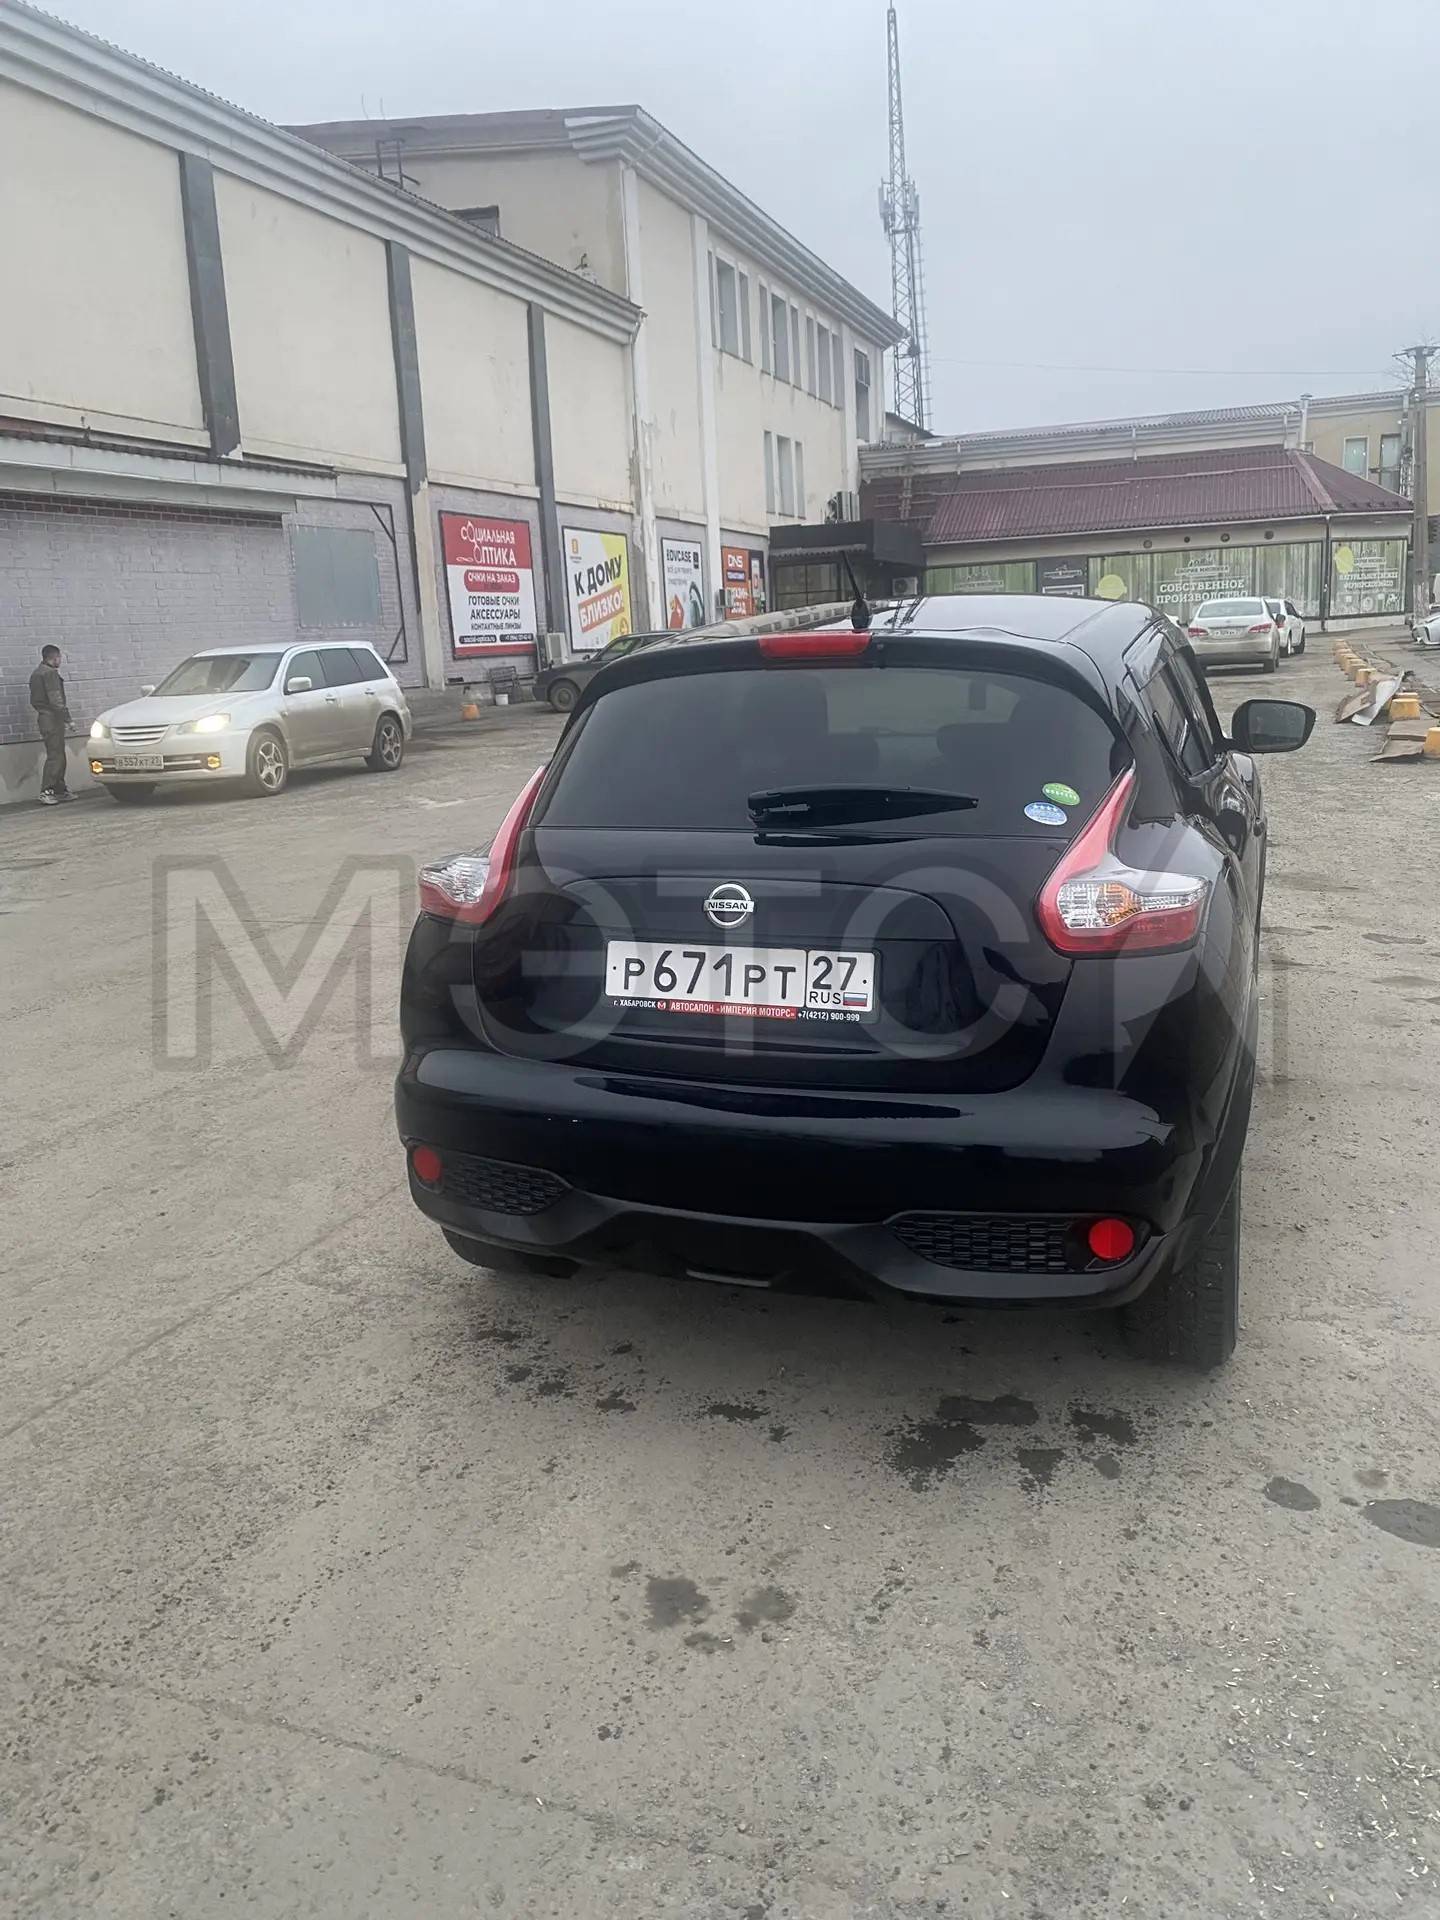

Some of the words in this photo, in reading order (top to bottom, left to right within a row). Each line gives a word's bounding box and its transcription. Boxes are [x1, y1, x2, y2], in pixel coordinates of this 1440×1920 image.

[461, 520, 515, 544] СОЦИАЛЬНАЯ
[473, 545, 517, 566] ОПТИКА
[727, 554, 743, 568] DNS
[467, 571, 486, 582] ОЧКИ
[487, 573, 496, 582] НА
[496, 573, 516, 583] ЗАКАЗ
[574, 571, 585, 597] К
[587, 554, 622, 596] ДОМУ
[1159, 579, 1245, 593] СОБСТВЕННОЕ
[468, 595, 500, 606] ГОТОВЫЕ
[501, 595, 519, 606] ОЧКИ
[470, 608, 521, 620] АКСЕССУАРЫ
[580, 590, 624, 627] БЛИЗКО!
[708, 901, 748, 910] NISSAN
[624, 950, 796, 999] Р671РТ
[812, 956, 857, 990] 27
[809, 991, 841, 1005] RUS
[620, 999, 656, 1009] ХАБАРОВСК
[670, 1003, 714, 1013] АВТОСАЛОН
[831, 1012, 860, 1022] 900-999
